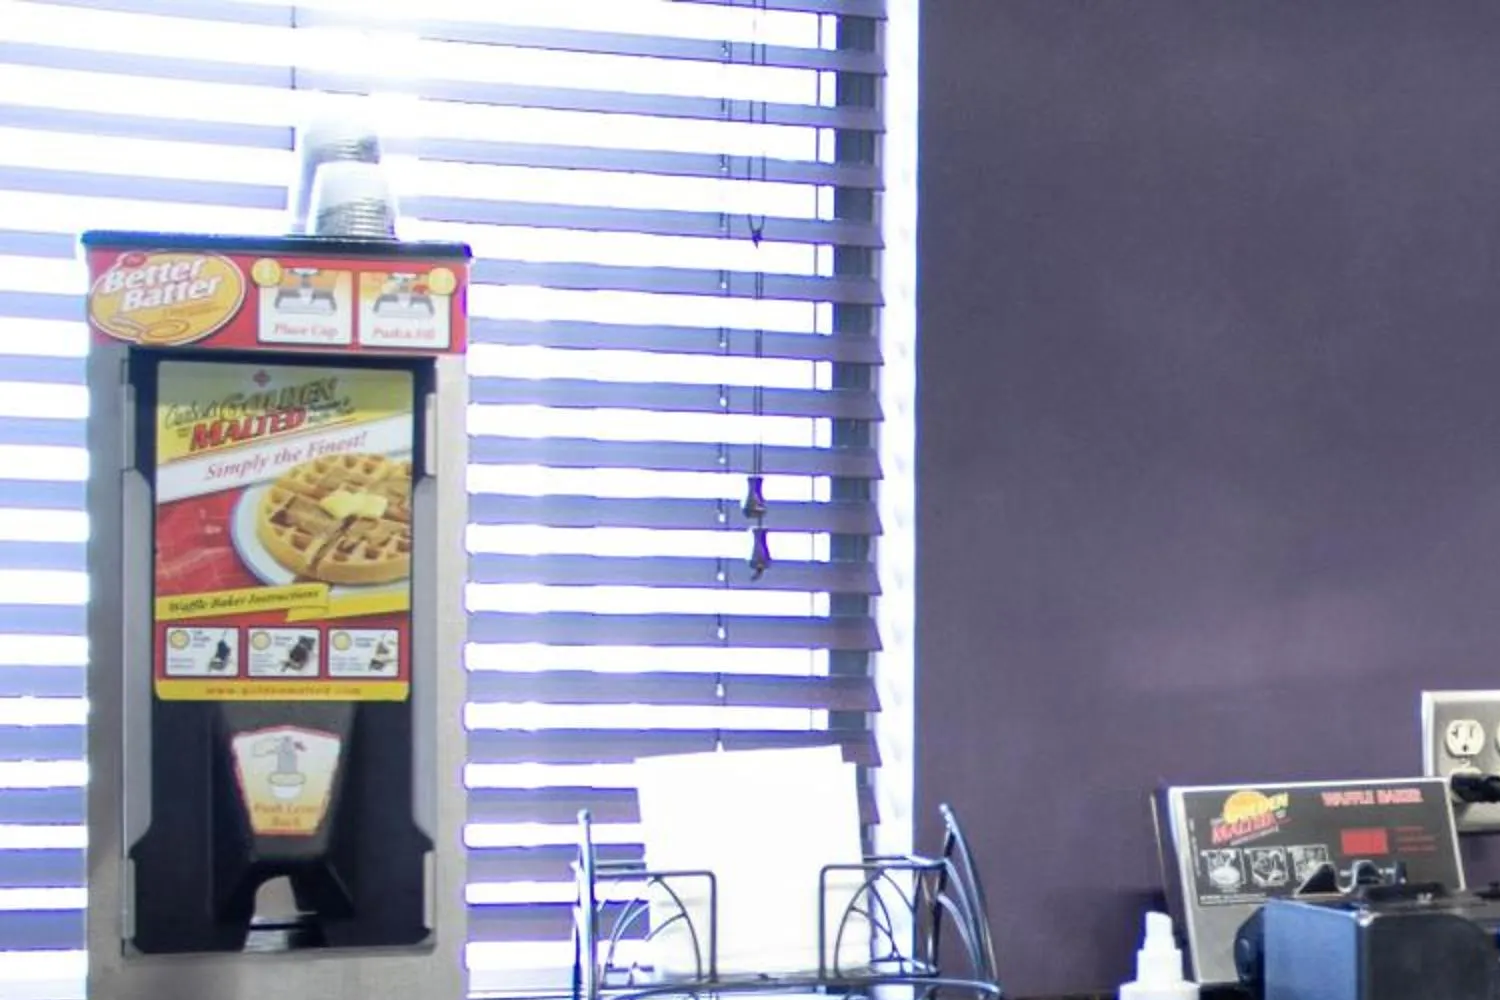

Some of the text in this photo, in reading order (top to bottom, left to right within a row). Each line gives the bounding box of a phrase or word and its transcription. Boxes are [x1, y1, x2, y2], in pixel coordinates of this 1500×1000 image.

[101, 256, 207, 294] Better
[121, 276, 223, 312] Batter
[189, 406, 308, 452] MALTED
[203, 430, 368, 481] Simply the Finest!
